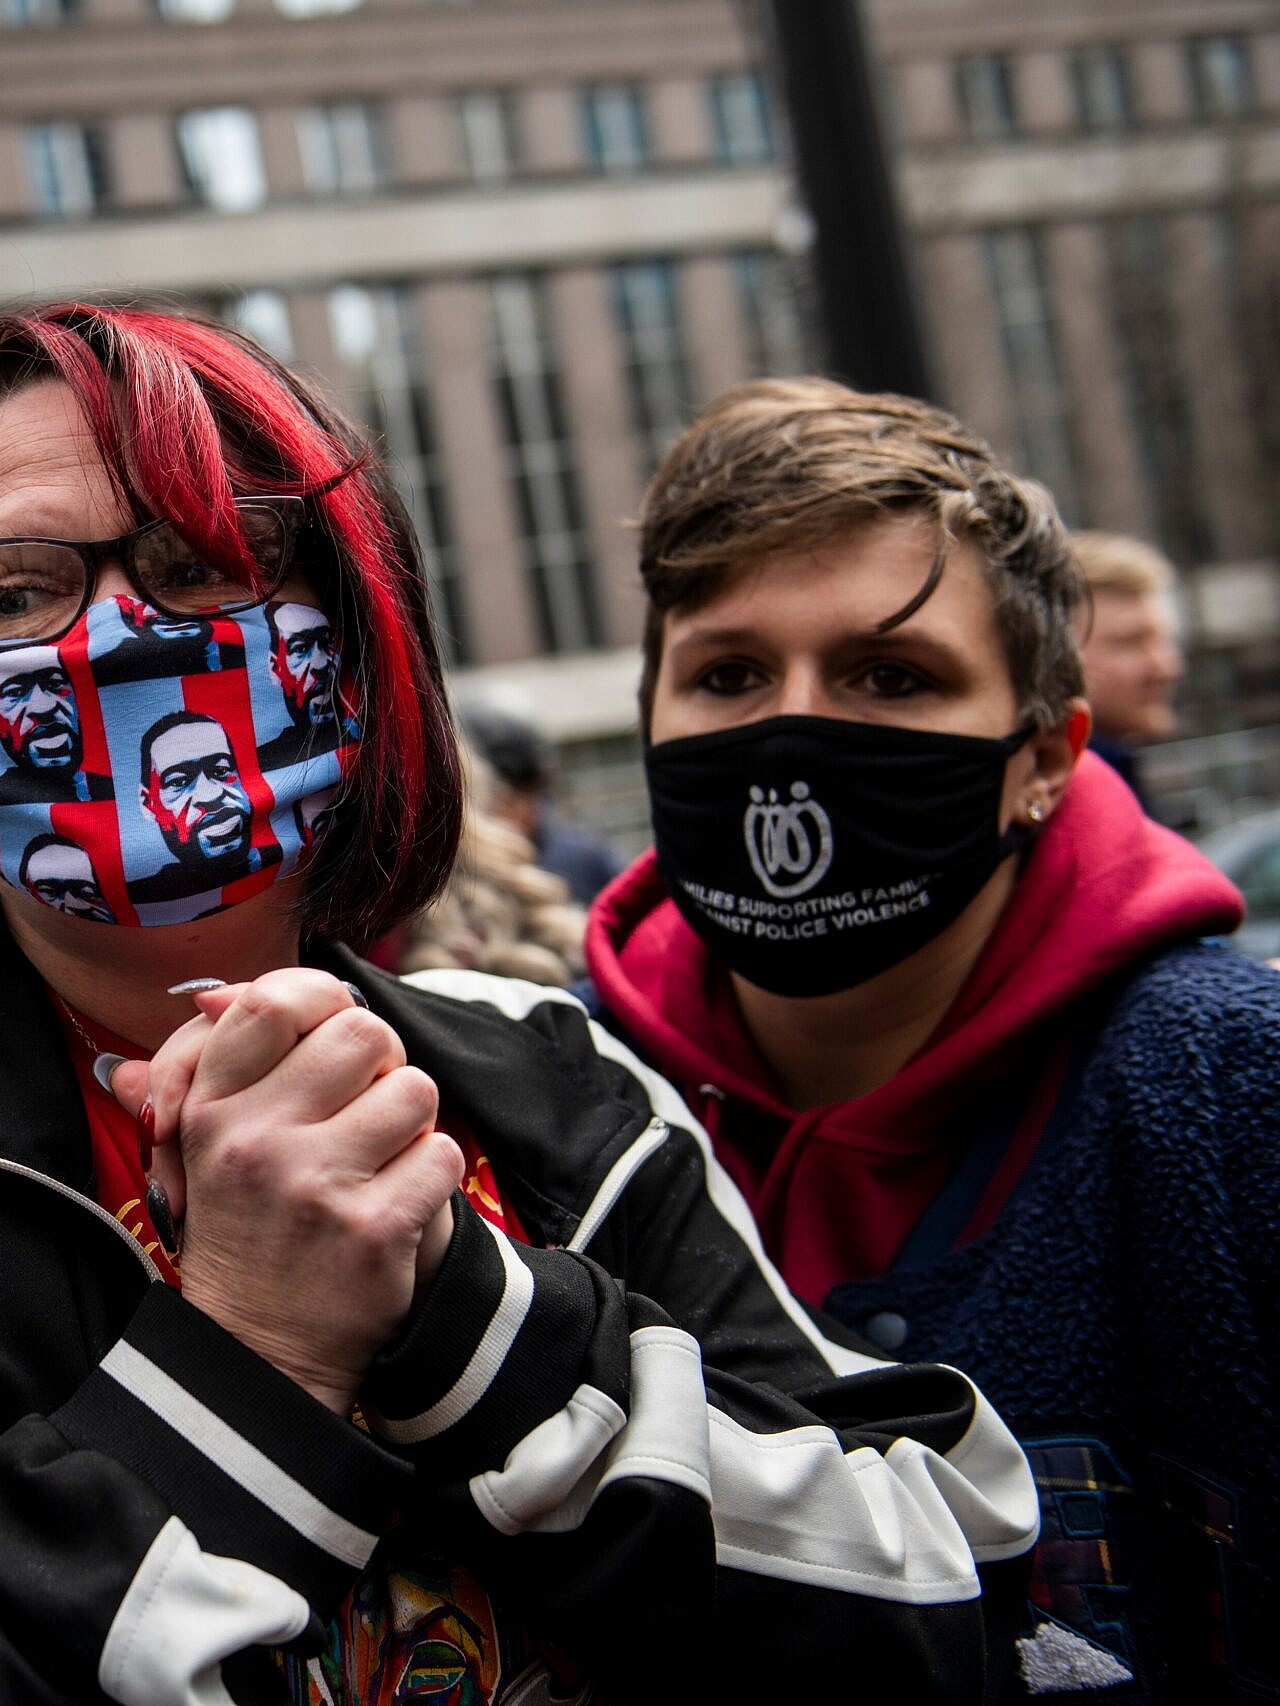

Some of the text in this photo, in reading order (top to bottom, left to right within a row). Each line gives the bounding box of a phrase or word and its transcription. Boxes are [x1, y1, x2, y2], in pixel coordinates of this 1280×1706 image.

[679, 879, 735, 911] MILIES
[738, 891, 857, 920] SUPPORTING
[755, 916, 828, 940] POLICE
[830, 890, 930, 932] VIOLENCE
